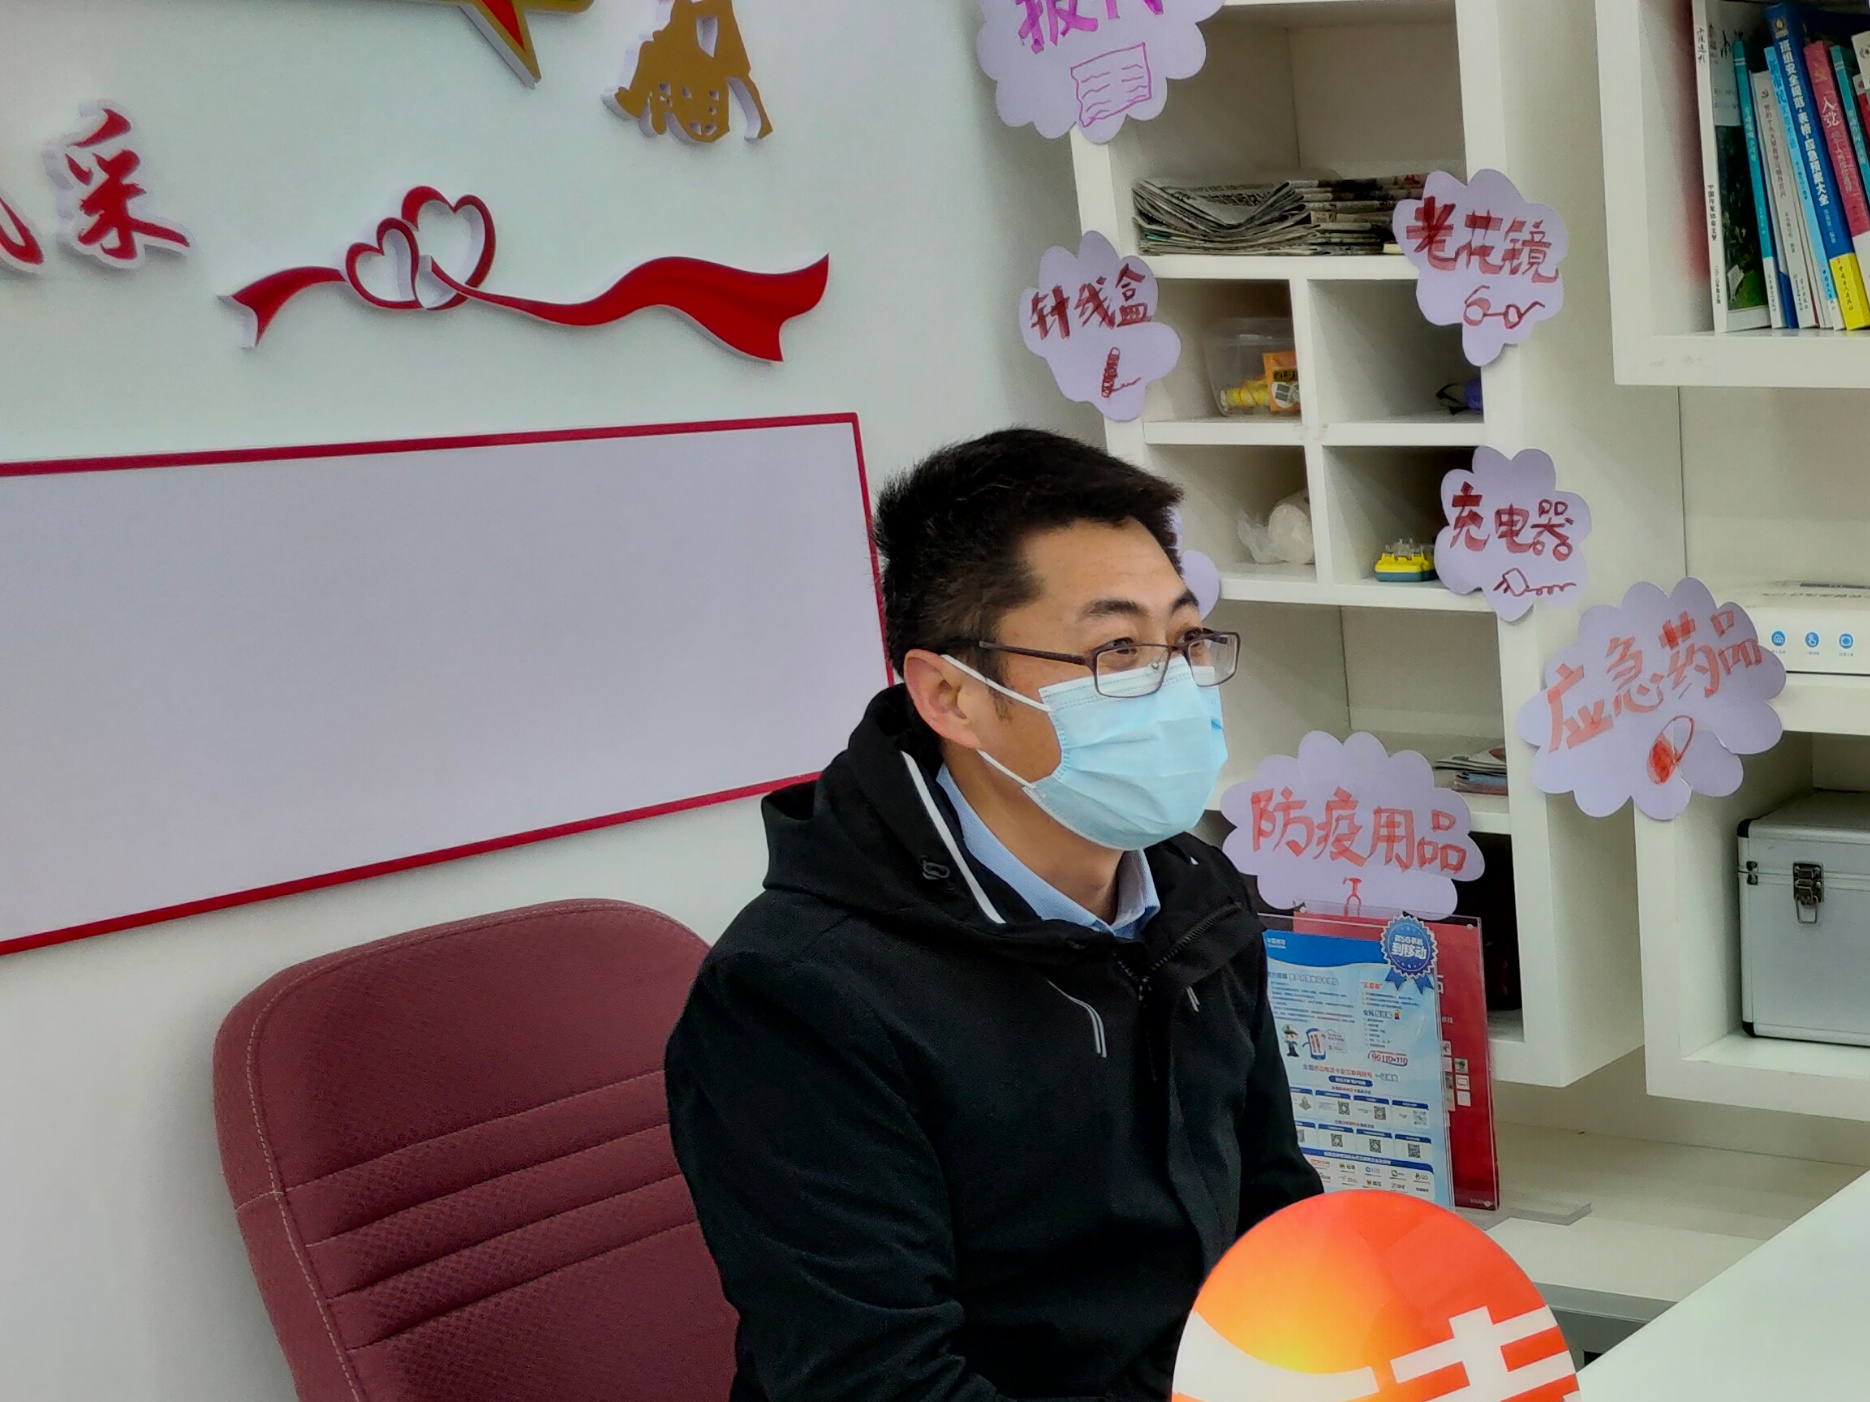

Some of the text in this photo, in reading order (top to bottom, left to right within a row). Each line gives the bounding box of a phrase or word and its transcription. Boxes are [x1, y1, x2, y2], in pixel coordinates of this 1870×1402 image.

[0, 106, 191, 261] 采
[1406, 196, 1561, 284] 老花镜
[1029, 262, 1155, 340] 针线盒
[1449, 480, 1575, 561] 充电器
[1546, 609, 1763, 753] 应急药品
[1249, 786, 1467, 873] 防疫用品
[1391, 941, 1427, 960] 到移动
